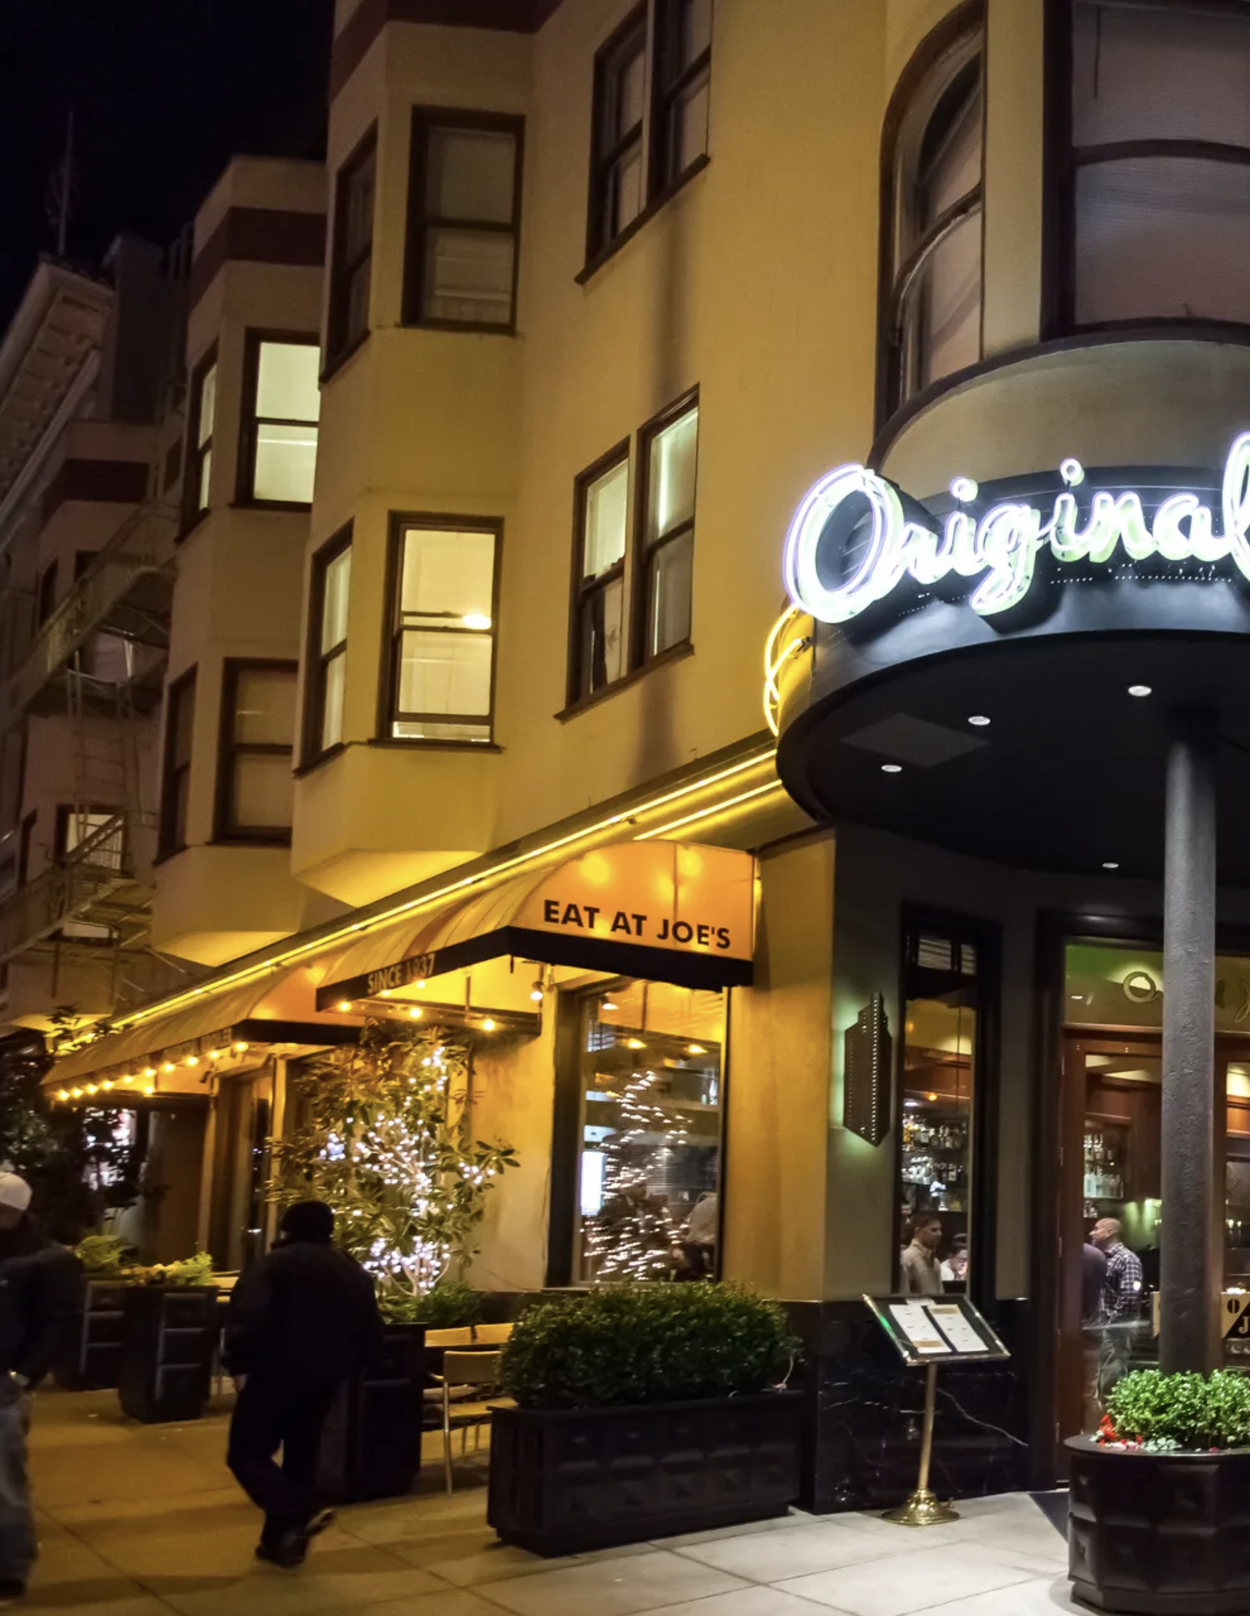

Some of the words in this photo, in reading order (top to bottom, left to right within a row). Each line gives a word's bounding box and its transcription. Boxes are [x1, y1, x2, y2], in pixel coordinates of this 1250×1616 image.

[543, 898, 601, 930] EAT
[610, 911, 648, 937] AT
[656, 917, 732, 950] JOE'S
[366, 963, 402, 995] SINCE
